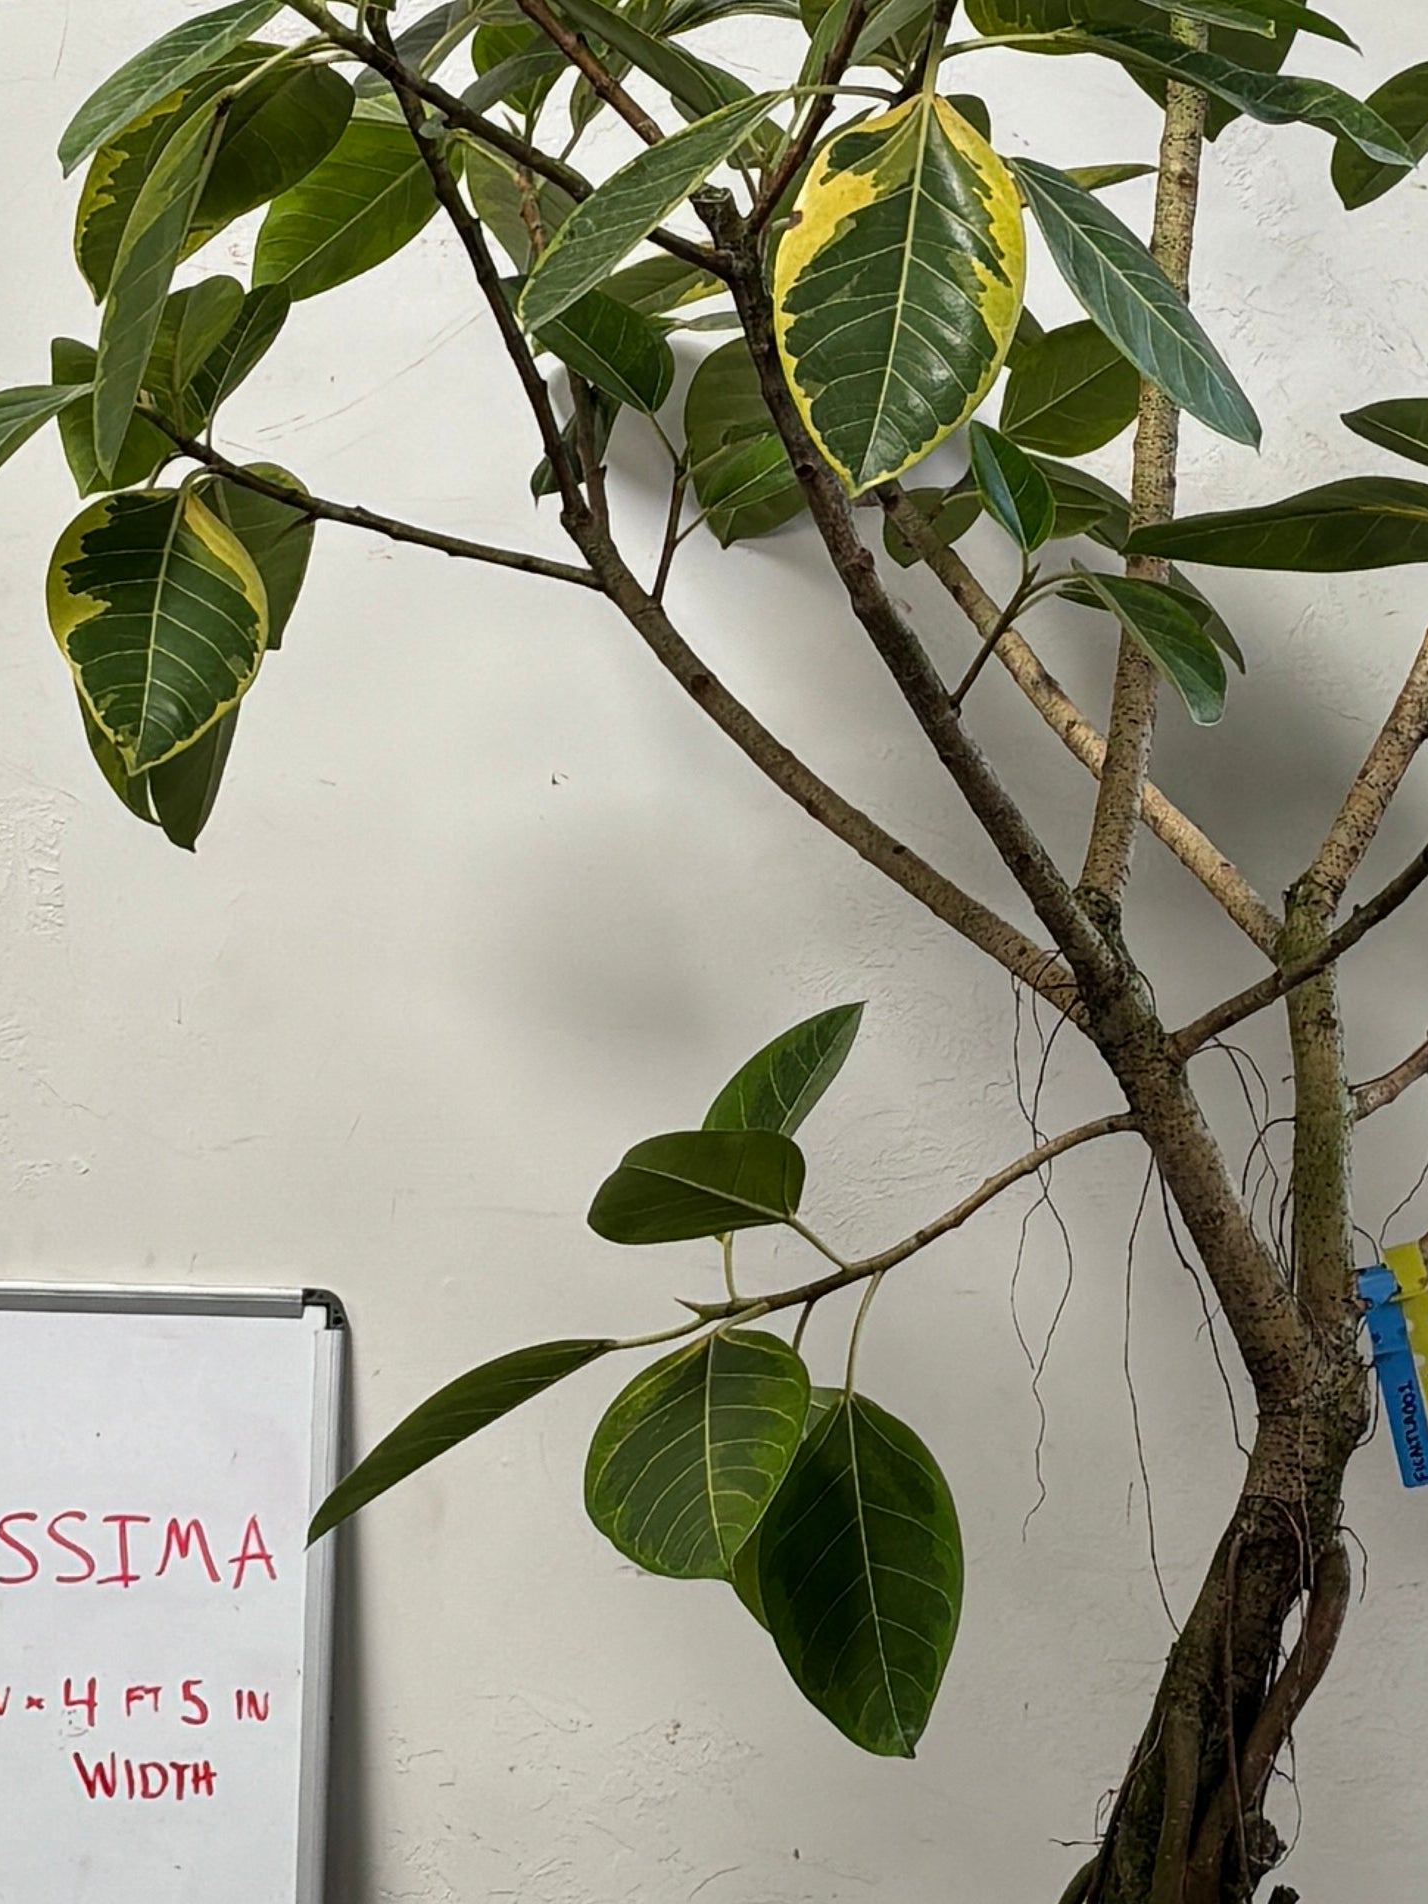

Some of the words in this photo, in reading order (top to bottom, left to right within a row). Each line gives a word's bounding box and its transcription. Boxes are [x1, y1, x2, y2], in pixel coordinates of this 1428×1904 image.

[63, 1676, 98, 1728] 4
[125, 1686, 163, 1717] FT
[181, 1679, 210, 1726] 5
[235, 1689, 270, 1723] IN
[72, 1751, 217, 1801] WIDTH
